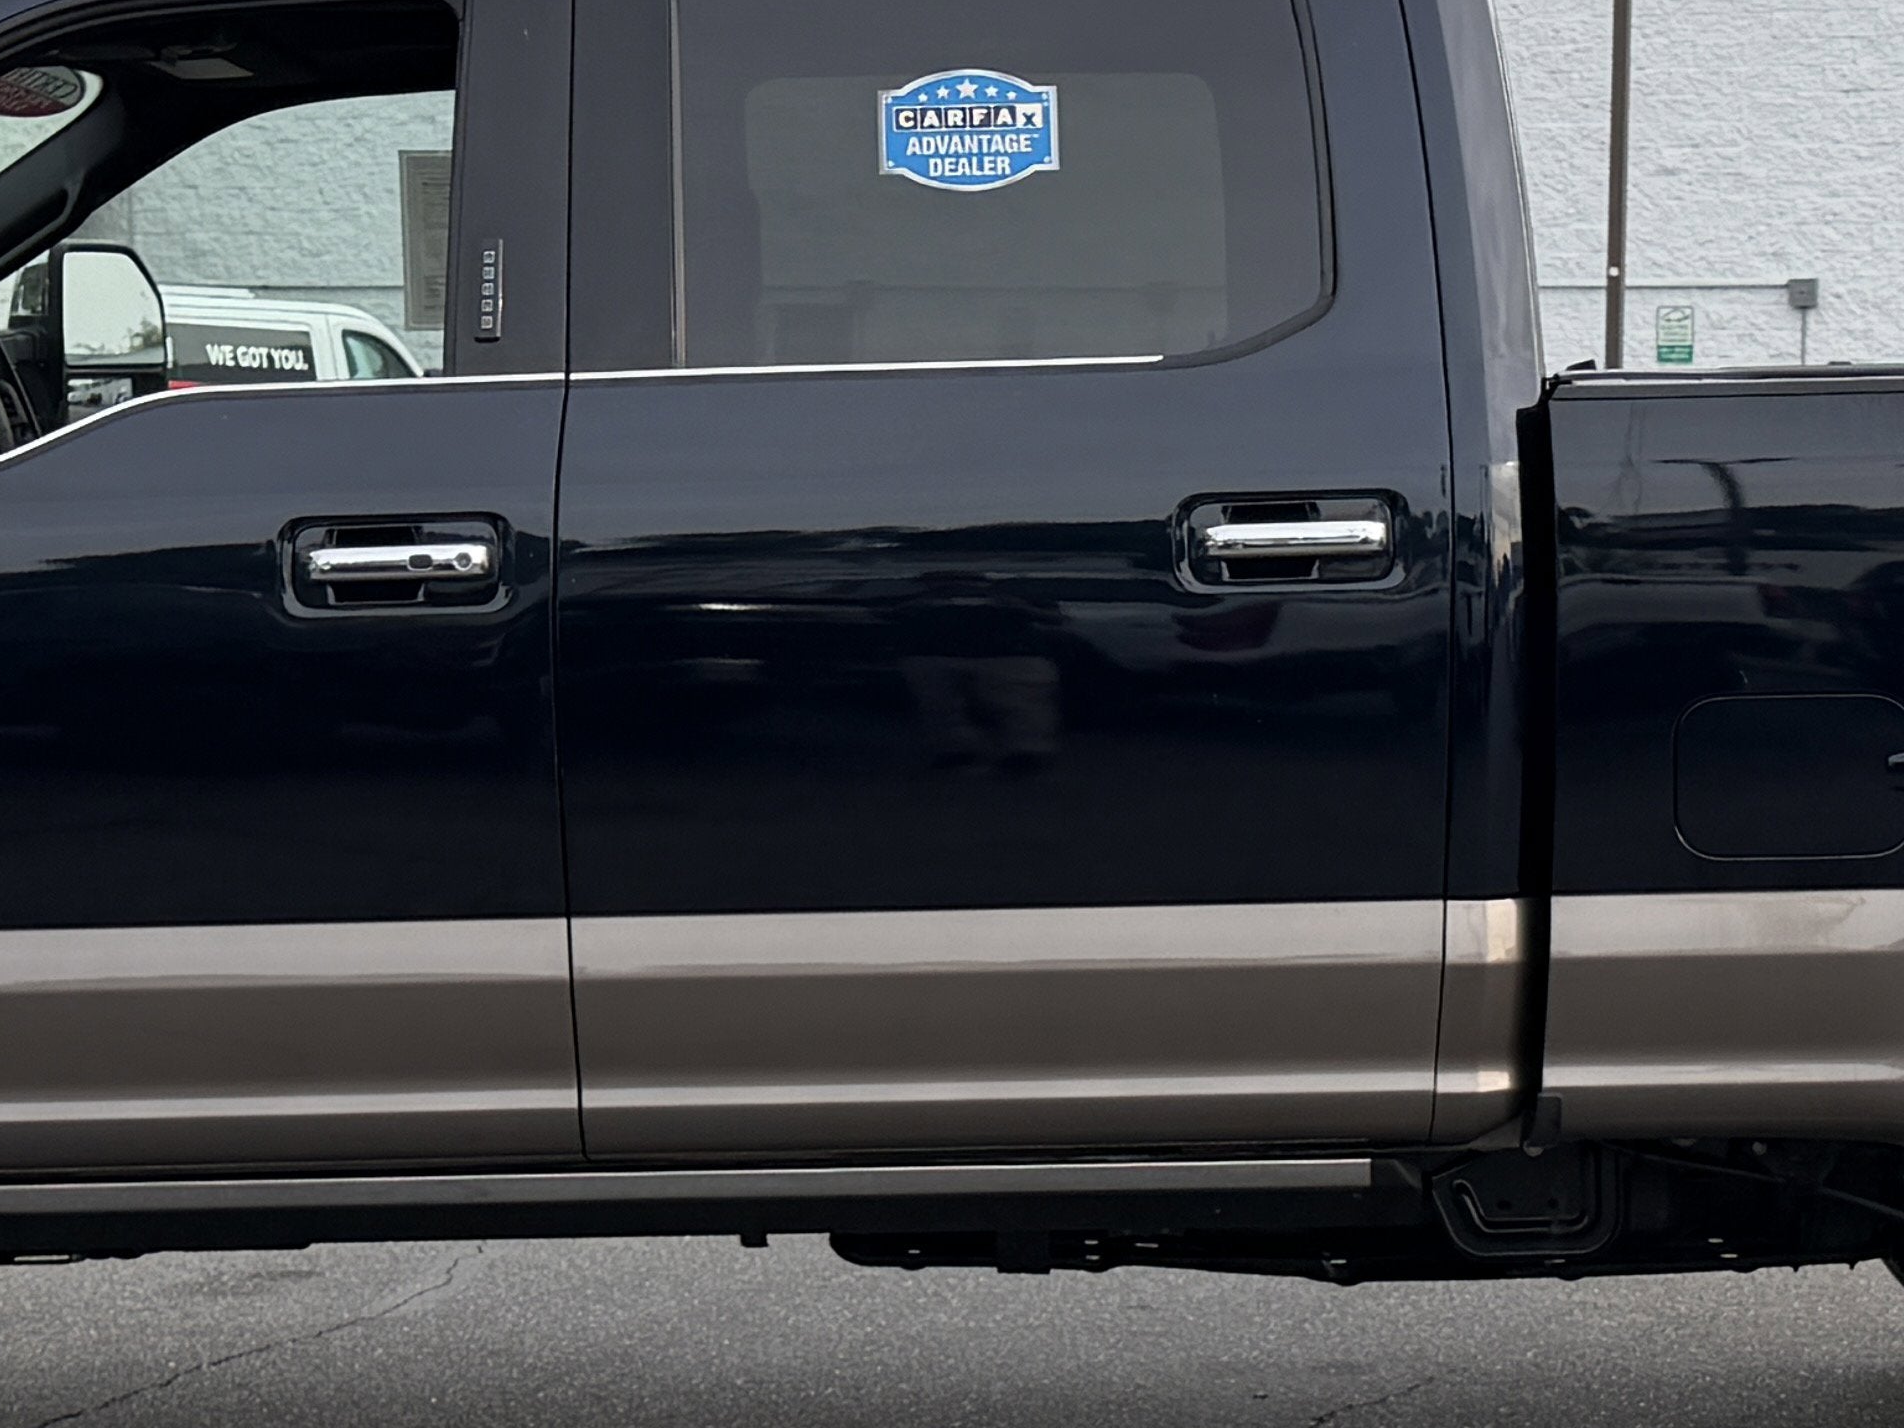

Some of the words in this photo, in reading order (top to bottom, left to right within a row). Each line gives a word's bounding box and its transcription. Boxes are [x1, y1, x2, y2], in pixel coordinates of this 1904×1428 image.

[896, 106, 1040, 130] CARFAX
[905, 133, 1033, 157] ADVANTAGE
[928, 156, 1012, 178] DEALER
[205, 343, 236, 368] WE
[236, 345, 270, 370] GOT
[269, 348, 309, 371] YOU.
